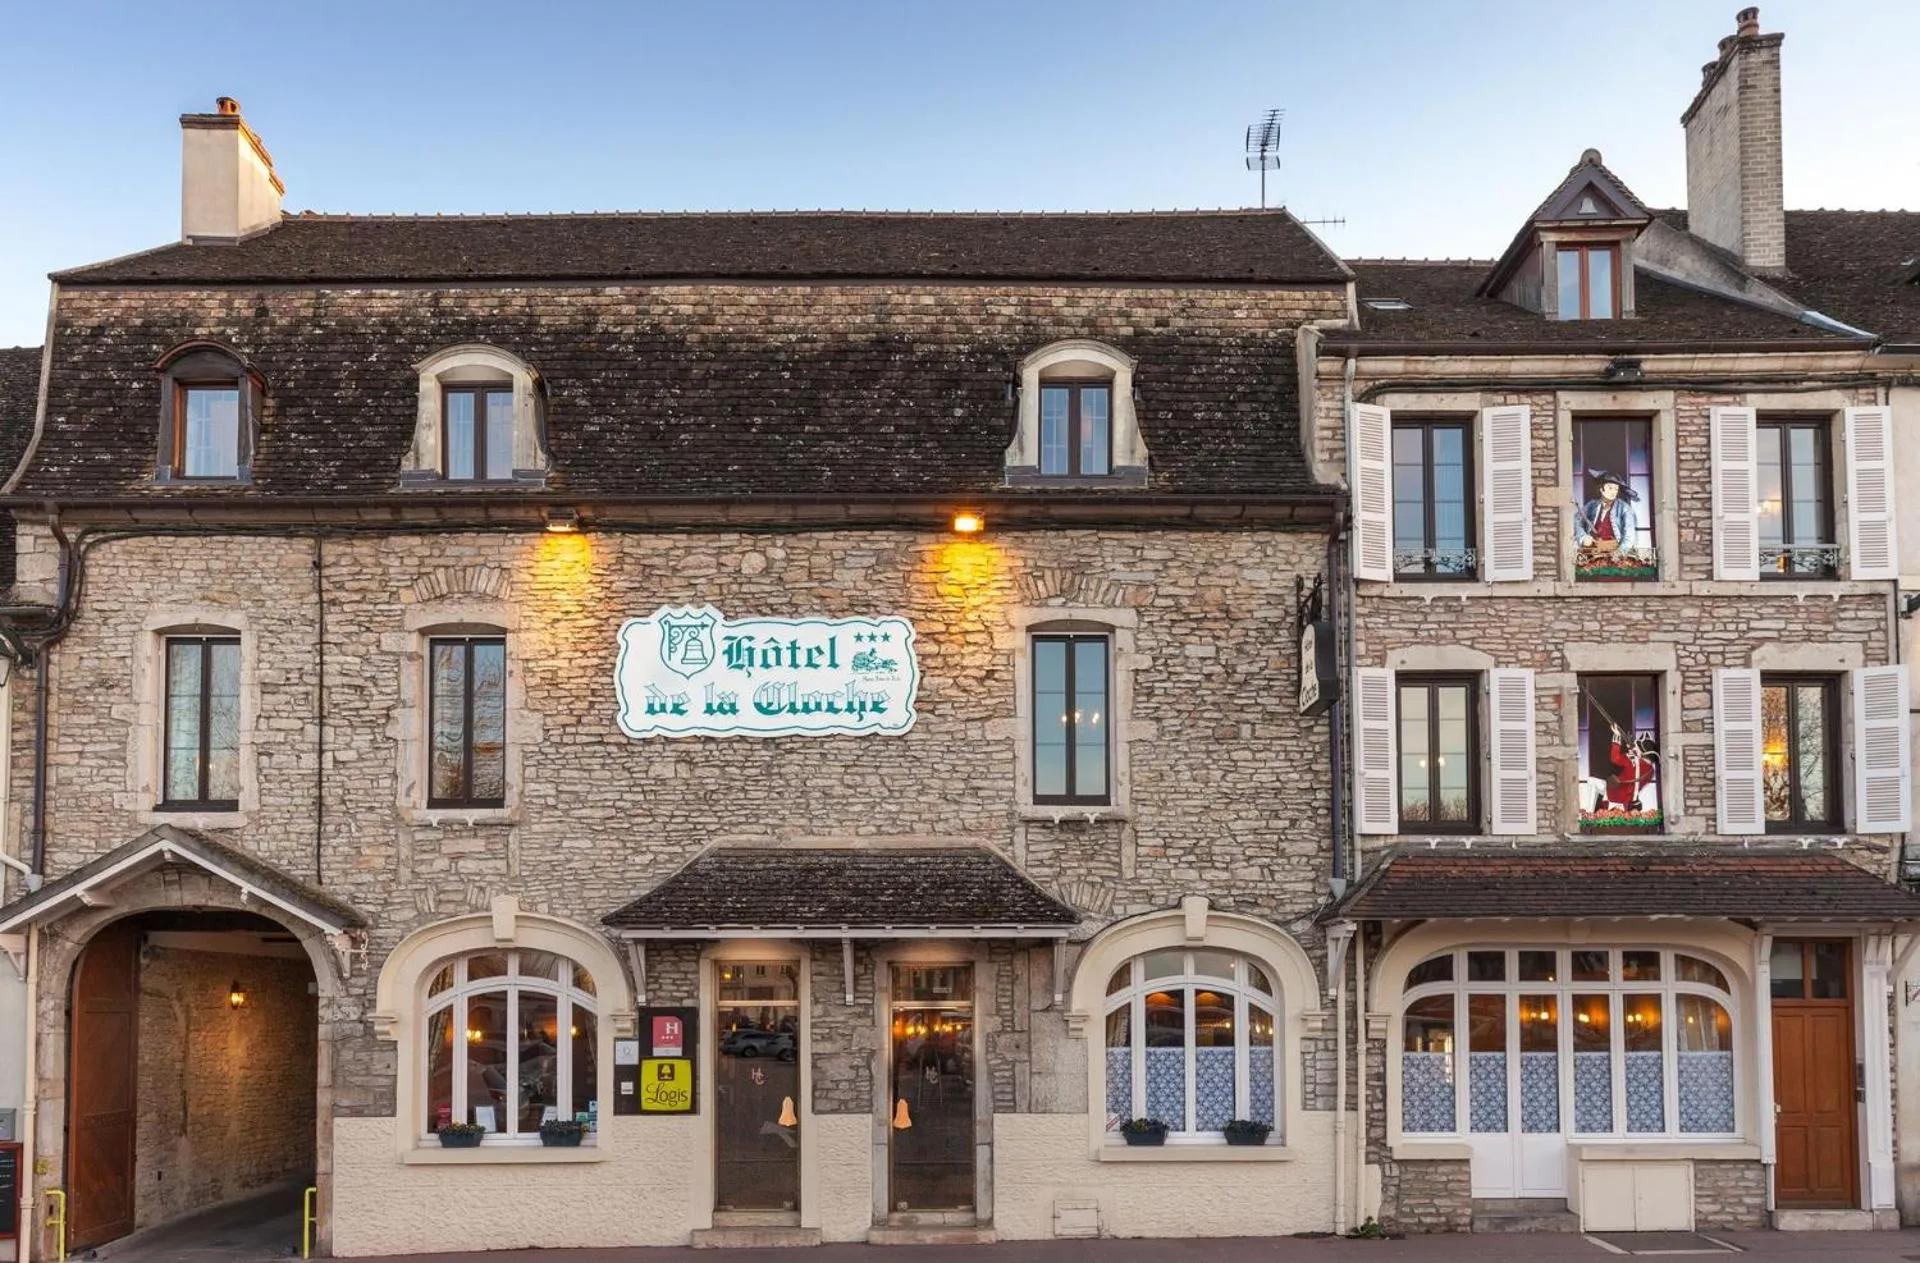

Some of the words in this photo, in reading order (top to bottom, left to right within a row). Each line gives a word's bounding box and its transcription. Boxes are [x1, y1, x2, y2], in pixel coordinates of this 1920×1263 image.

[722, 634, 841, 678] Hôtel
[644, 682, 691, 716] de
[702, 681, 742, 716] la
[752, 680, 892, 722] Cloche
[665, 1021, 679, 1035] H
[645, 1082, 689, 1108] Logis
